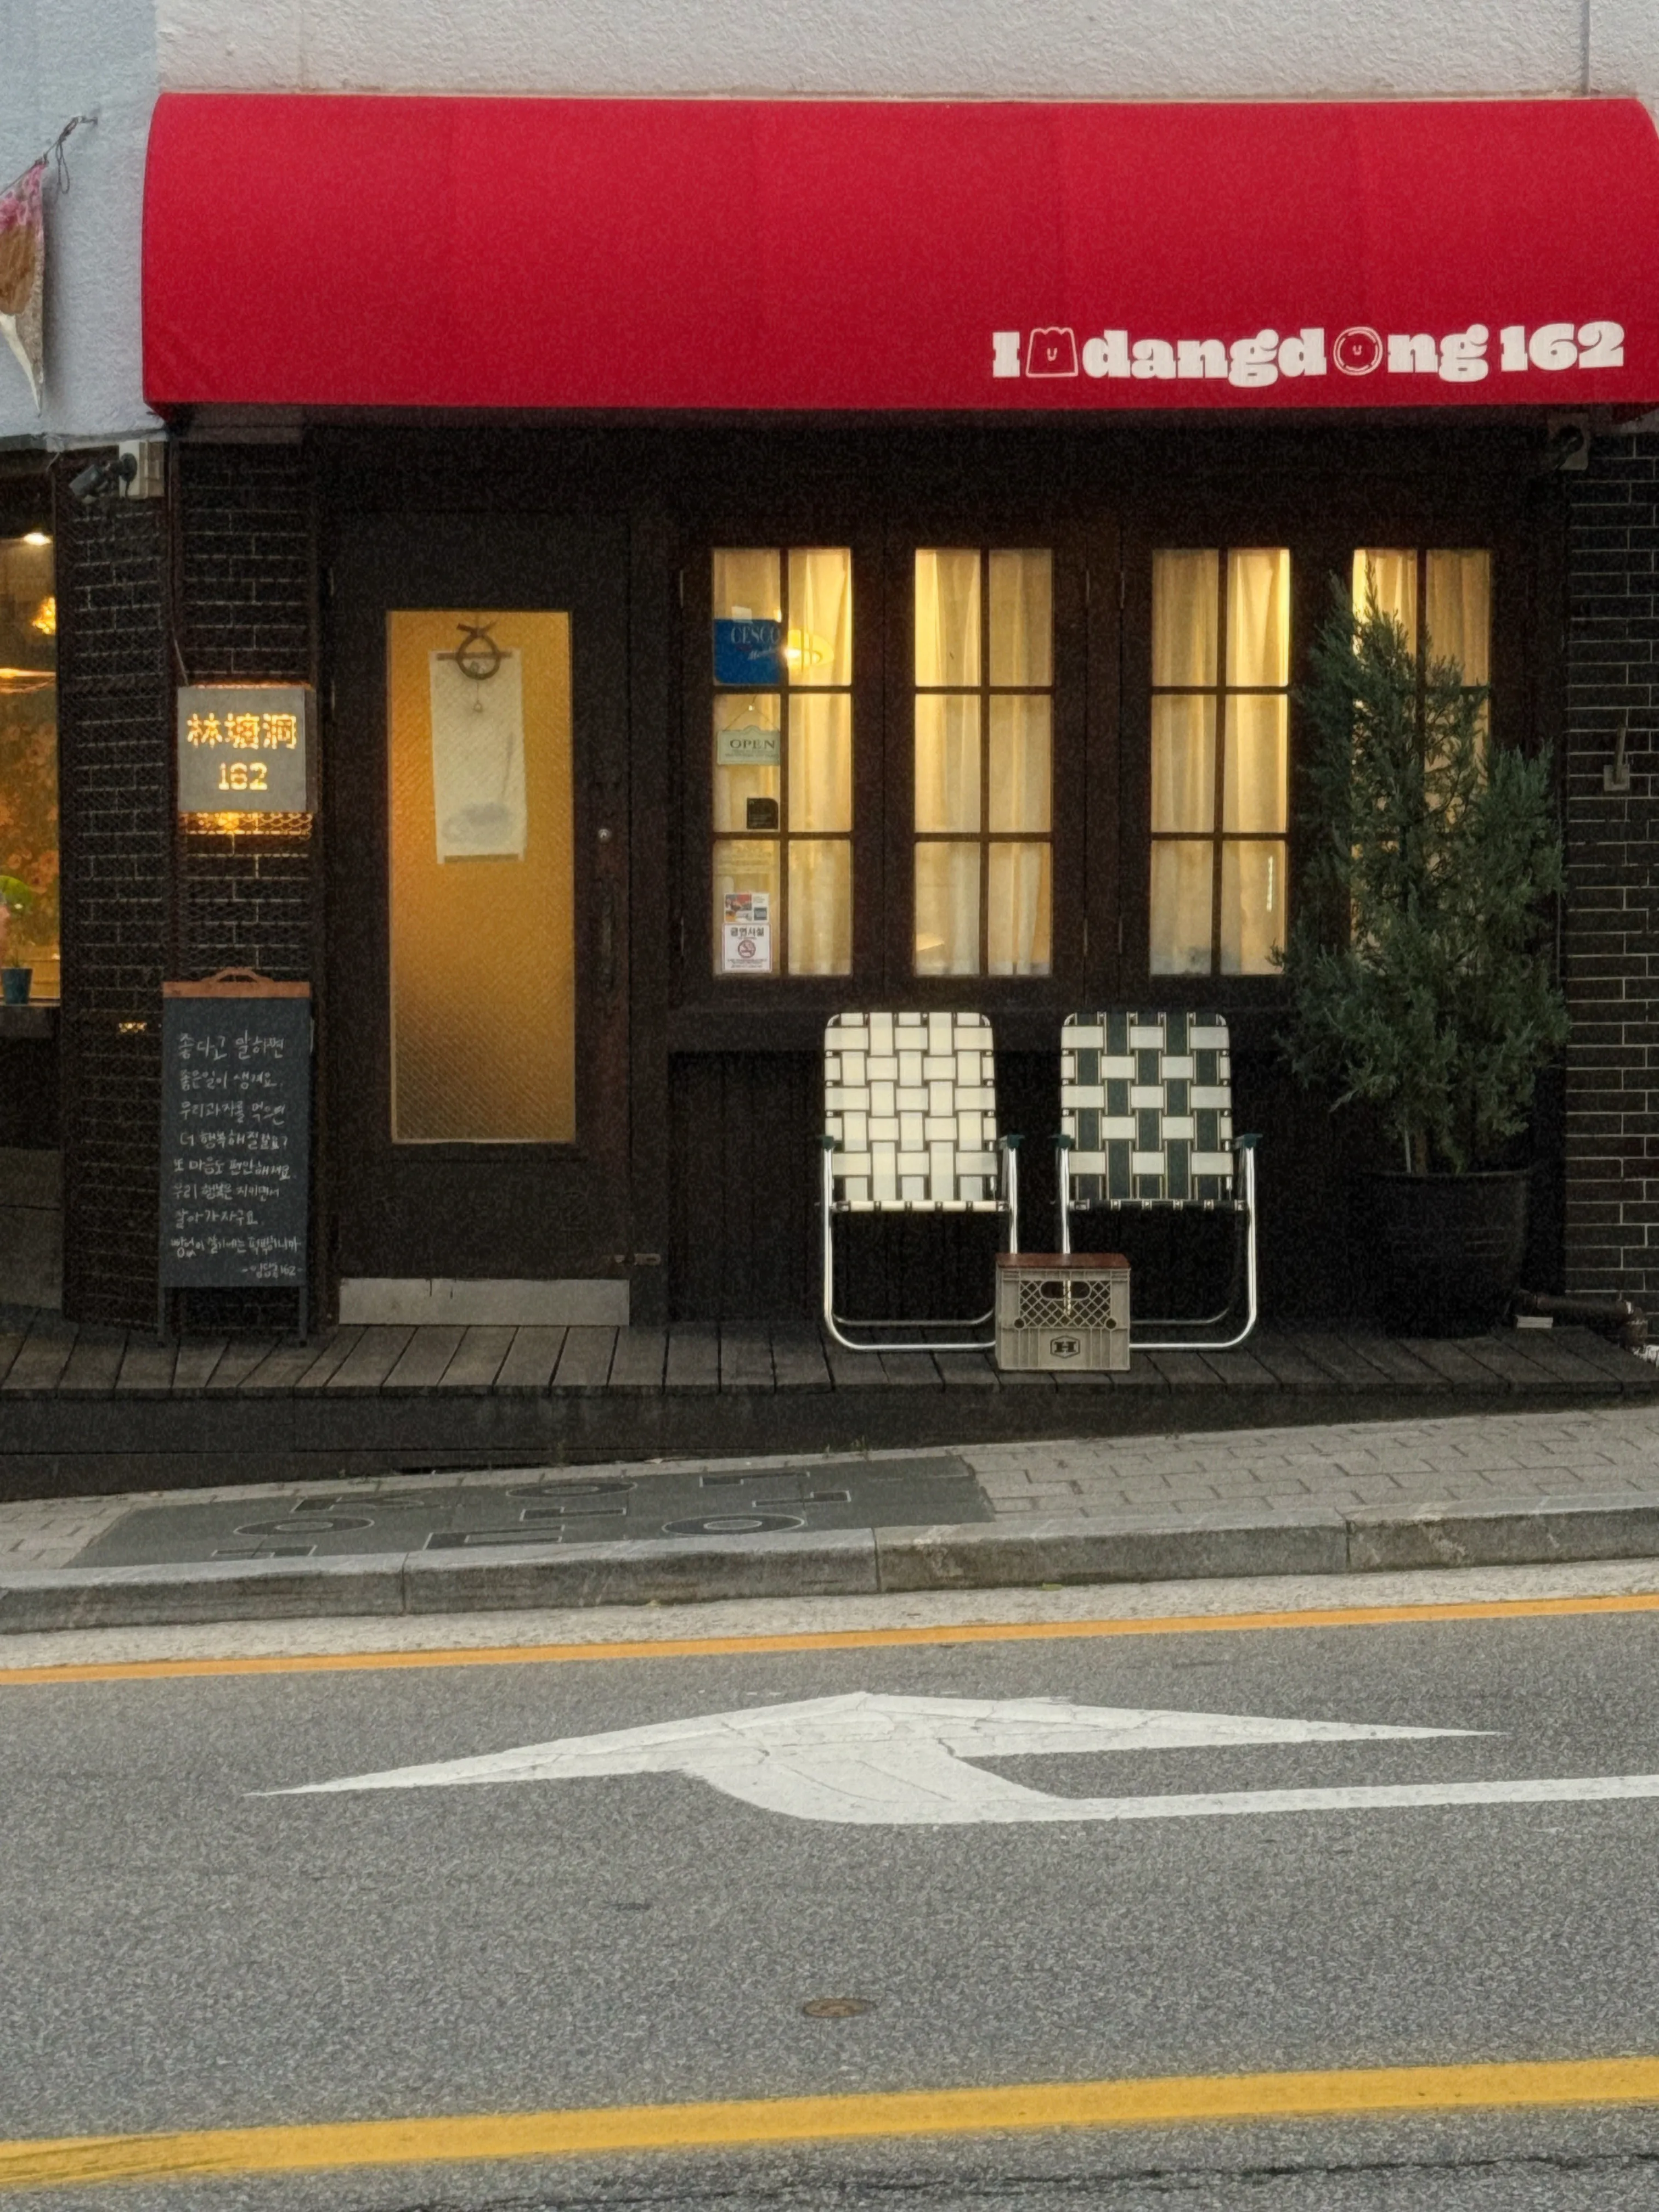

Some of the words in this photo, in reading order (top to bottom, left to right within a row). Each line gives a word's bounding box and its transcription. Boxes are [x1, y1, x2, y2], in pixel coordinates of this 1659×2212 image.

[731, 627, 781, 644] CESCO
[730, 738, 775, 749] OPEN
[218, 762, 268, 790] 162
[177, 1031, 228, 1061] 좋다고
[235, 1029, 285, 1060] 말하면
[251, 1101, 286, 1126] 먹으면
[180, 1131, 194, 1148] 더
[173, 1157, 185, 1173] 또
[188, 1156, 225, 1176] 마음도
[172, 1183, 198, 1200] 우리
[200, 1182, 233, 1201] 행복은
[235, 1183, 280, 1203] 지키면서
[1054, 1341, 1076, 1353] H
